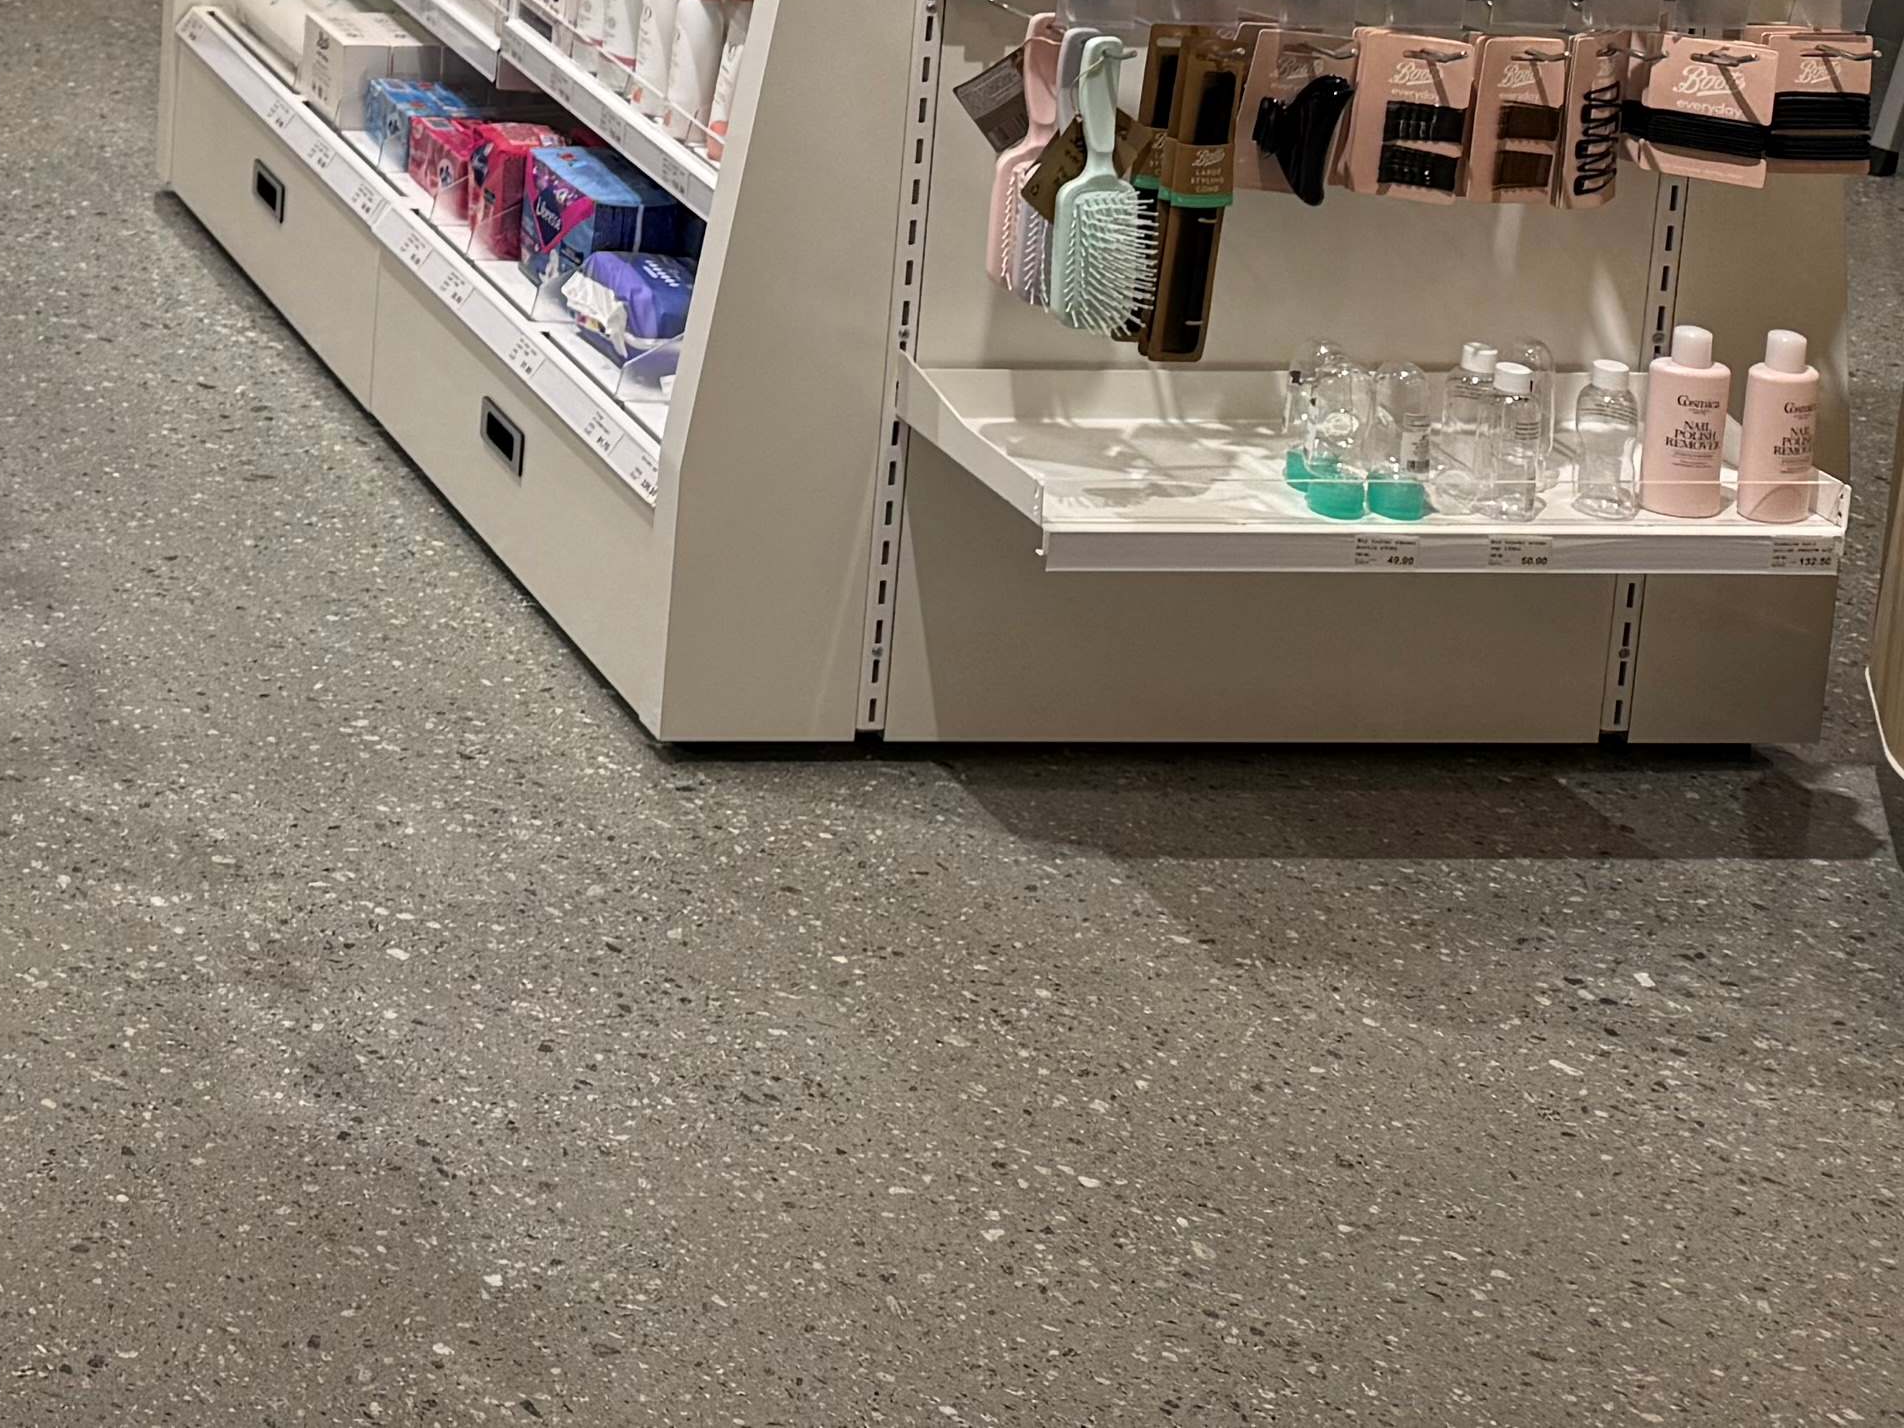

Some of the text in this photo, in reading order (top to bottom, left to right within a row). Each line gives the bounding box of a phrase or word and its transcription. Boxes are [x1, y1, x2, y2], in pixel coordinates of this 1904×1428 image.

[1673, 65, 1746, 97] Boots
[1676, 98, 1743, 118] everyday
[1677, 394, 1720, 409] Cosmica
[1683, 421, 1710, 431] NAIL
[1675, 429, 1717, 440] POLISH
